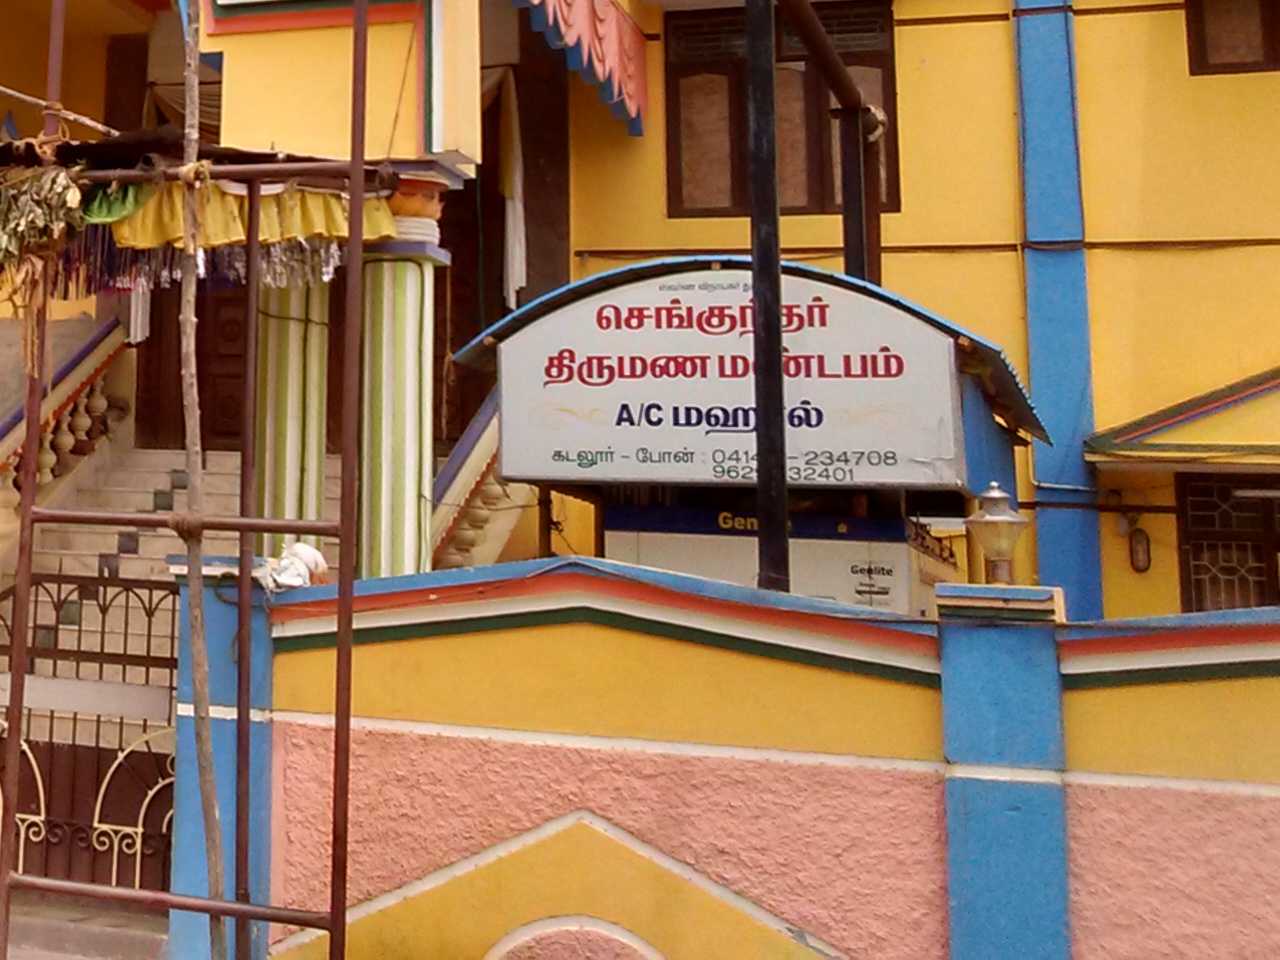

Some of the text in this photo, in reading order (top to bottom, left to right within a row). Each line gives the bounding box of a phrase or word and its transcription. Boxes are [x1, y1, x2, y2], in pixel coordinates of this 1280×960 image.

[544, 348, 710, 387] திருமண
[615, 399, 824, 437] A/C மஹல்
[551, 446, 615, 468] கடலூர்
[635, 446, 695, 464] போன்
[804, 450, 898, 468] 234708
[712, 465, 855, 482] 96232401
